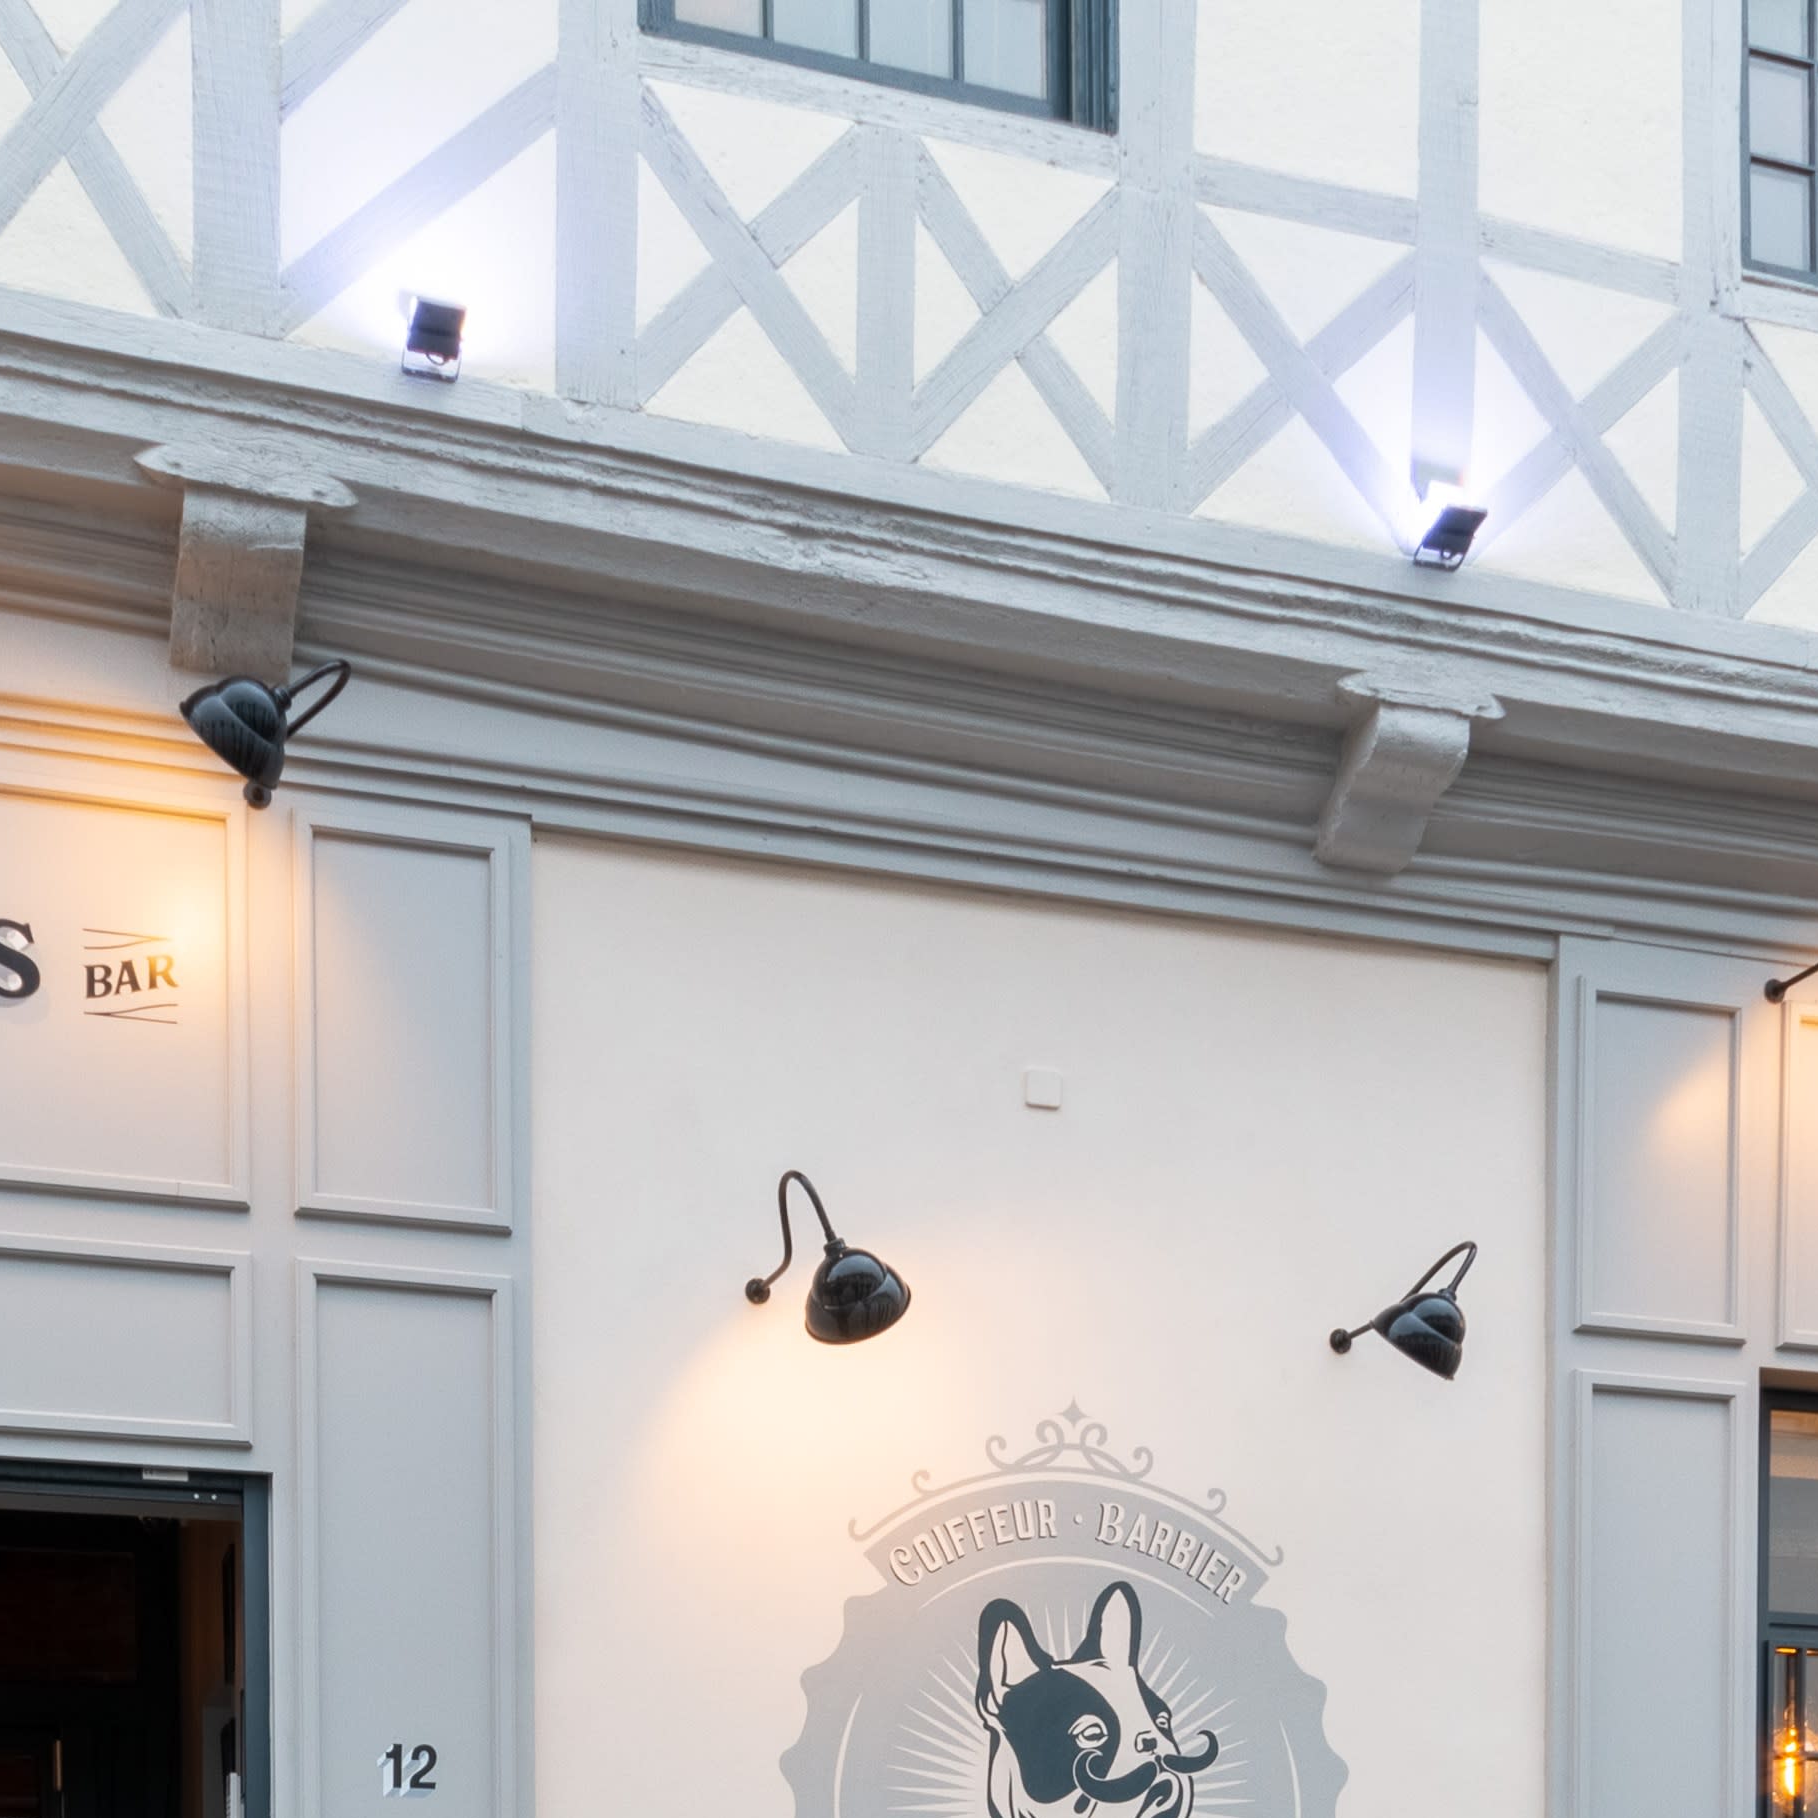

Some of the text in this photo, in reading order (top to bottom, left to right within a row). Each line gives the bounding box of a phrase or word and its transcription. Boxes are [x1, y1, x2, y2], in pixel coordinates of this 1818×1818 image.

[84, 953, 180, 1000] BAR
[888, 1498, 1247, 1605] COIFFEUR BARBIER
[382, 1743, 438, 1793] 12
